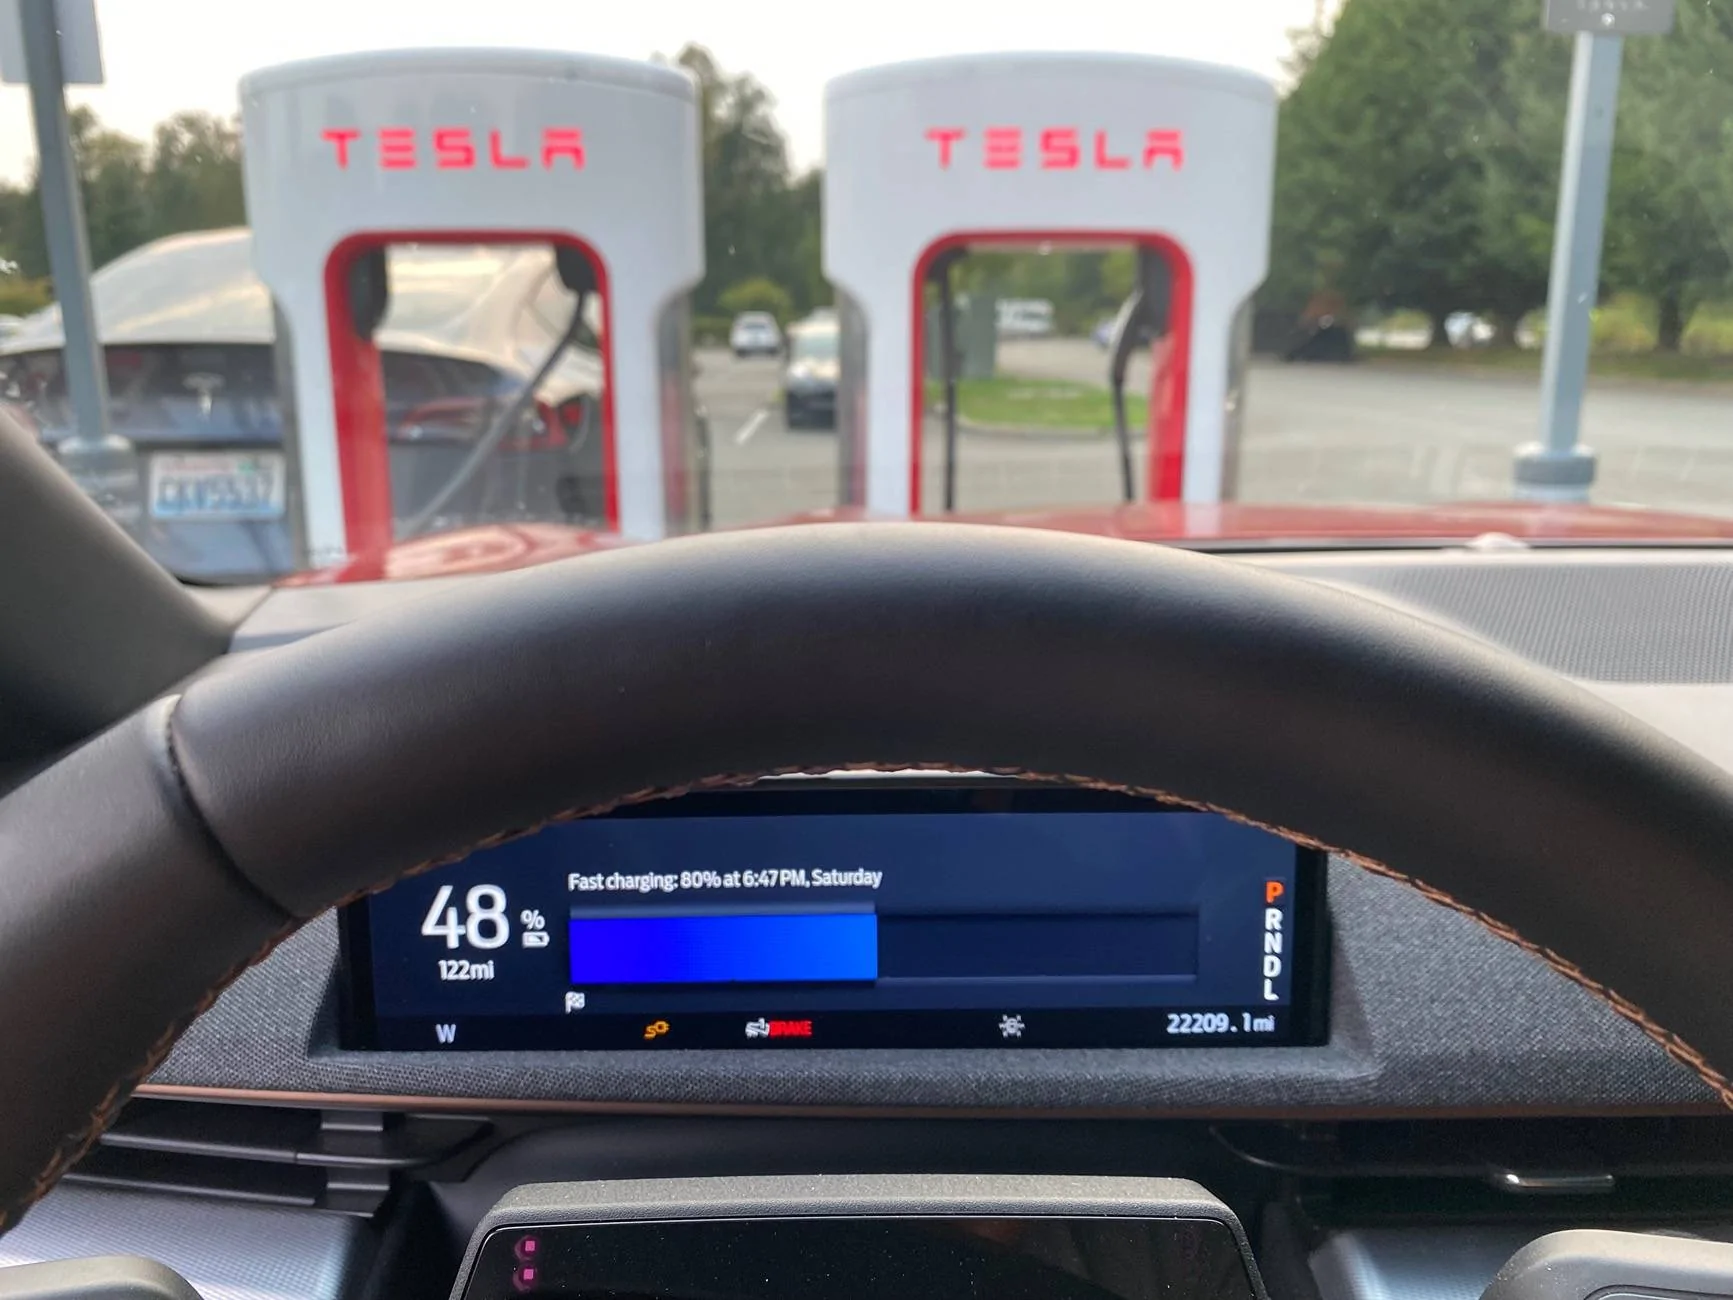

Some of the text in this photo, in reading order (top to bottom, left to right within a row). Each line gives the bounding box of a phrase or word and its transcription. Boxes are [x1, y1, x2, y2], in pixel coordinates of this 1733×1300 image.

[321, 128, 585, 170] TESLA
[925, 127, 1184, 170] TESLA
[568, 868, 883, 893] Fast charging: 80% at 6:47 PM, Saturday
[421, 884, 545, 949] 48 %
[436, 1023, 456, 1044] W
